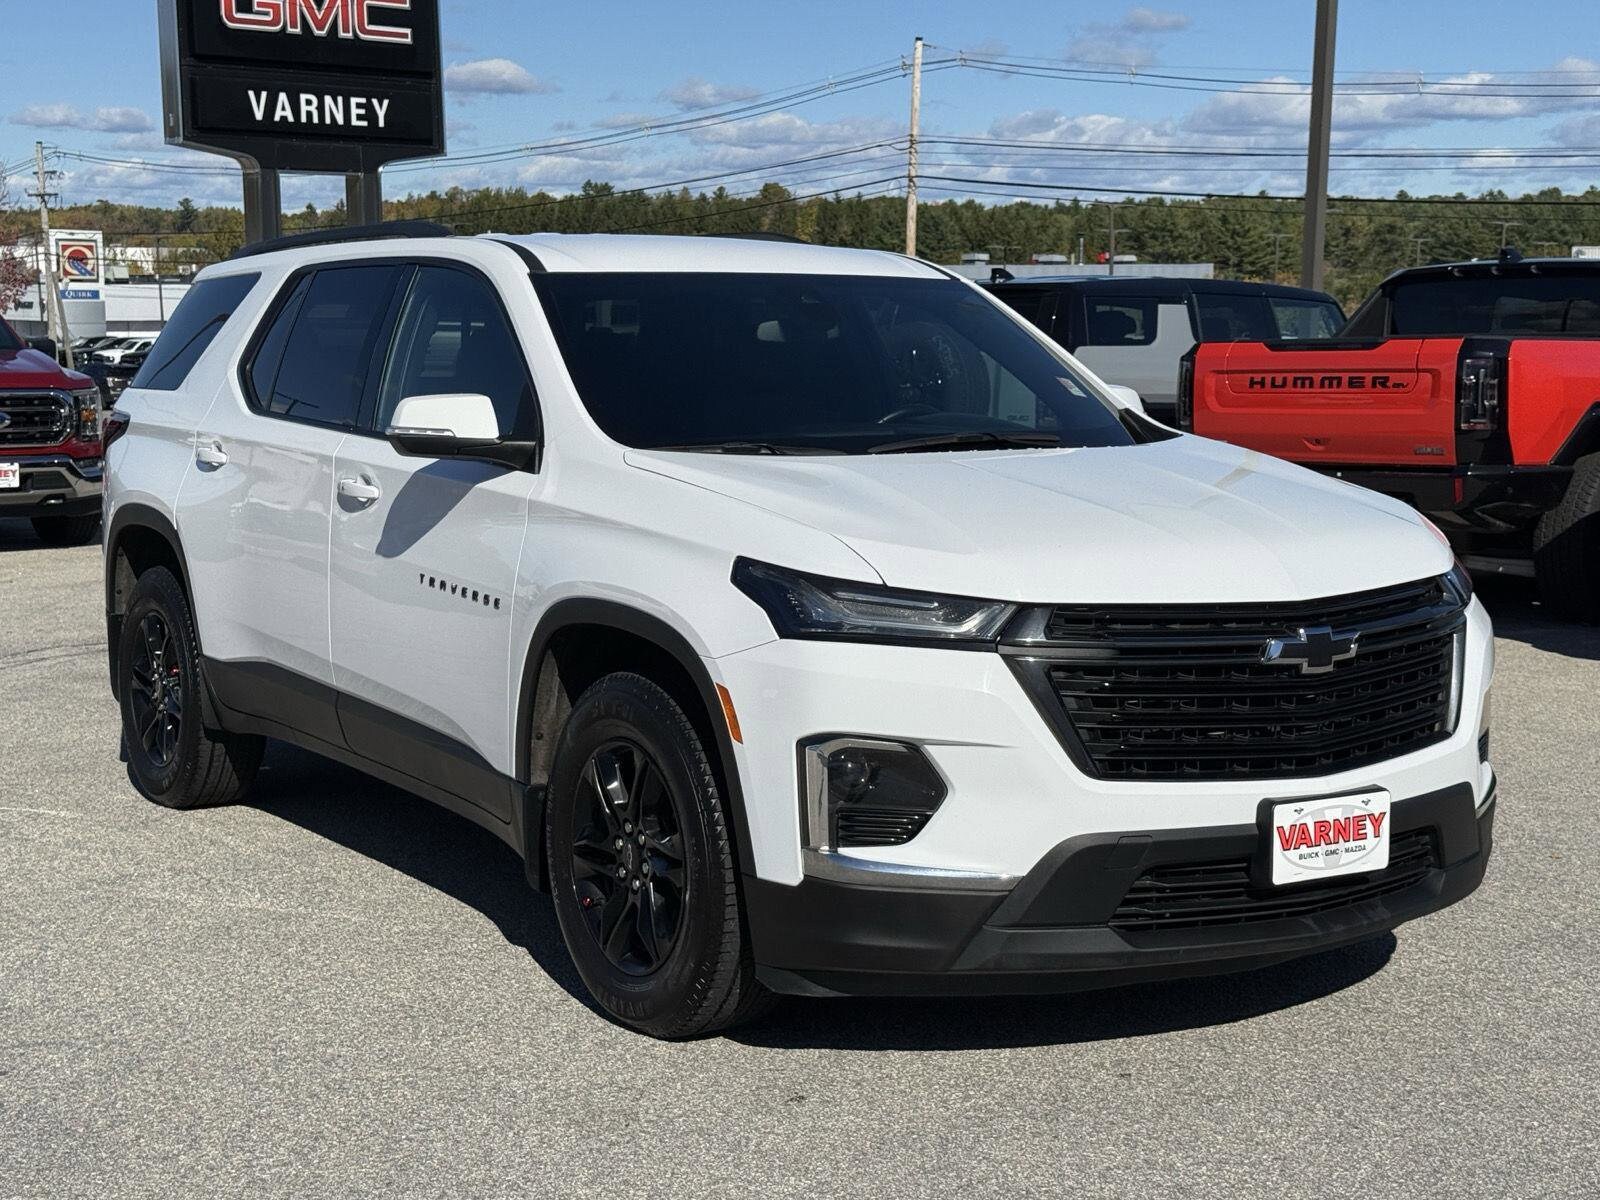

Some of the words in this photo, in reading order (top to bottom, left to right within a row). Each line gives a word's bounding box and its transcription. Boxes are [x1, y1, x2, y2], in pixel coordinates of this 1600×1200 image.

[219, 0, 412, 45] GMC
[247, 89, 390, 128] VARNEY
[65, 290, 93, 298] QUIRK
[1248, 375, 1391, 389] HUMMER
[419, 573, 501, 610] TRAVERSE
[1276, 812, 1387, 851] VARNEY
[1298, 851, 1320, 861] BUICK
[1324, 849, 1340, 858] GMC
[1344, 844, 1367, 854] MAZDA
